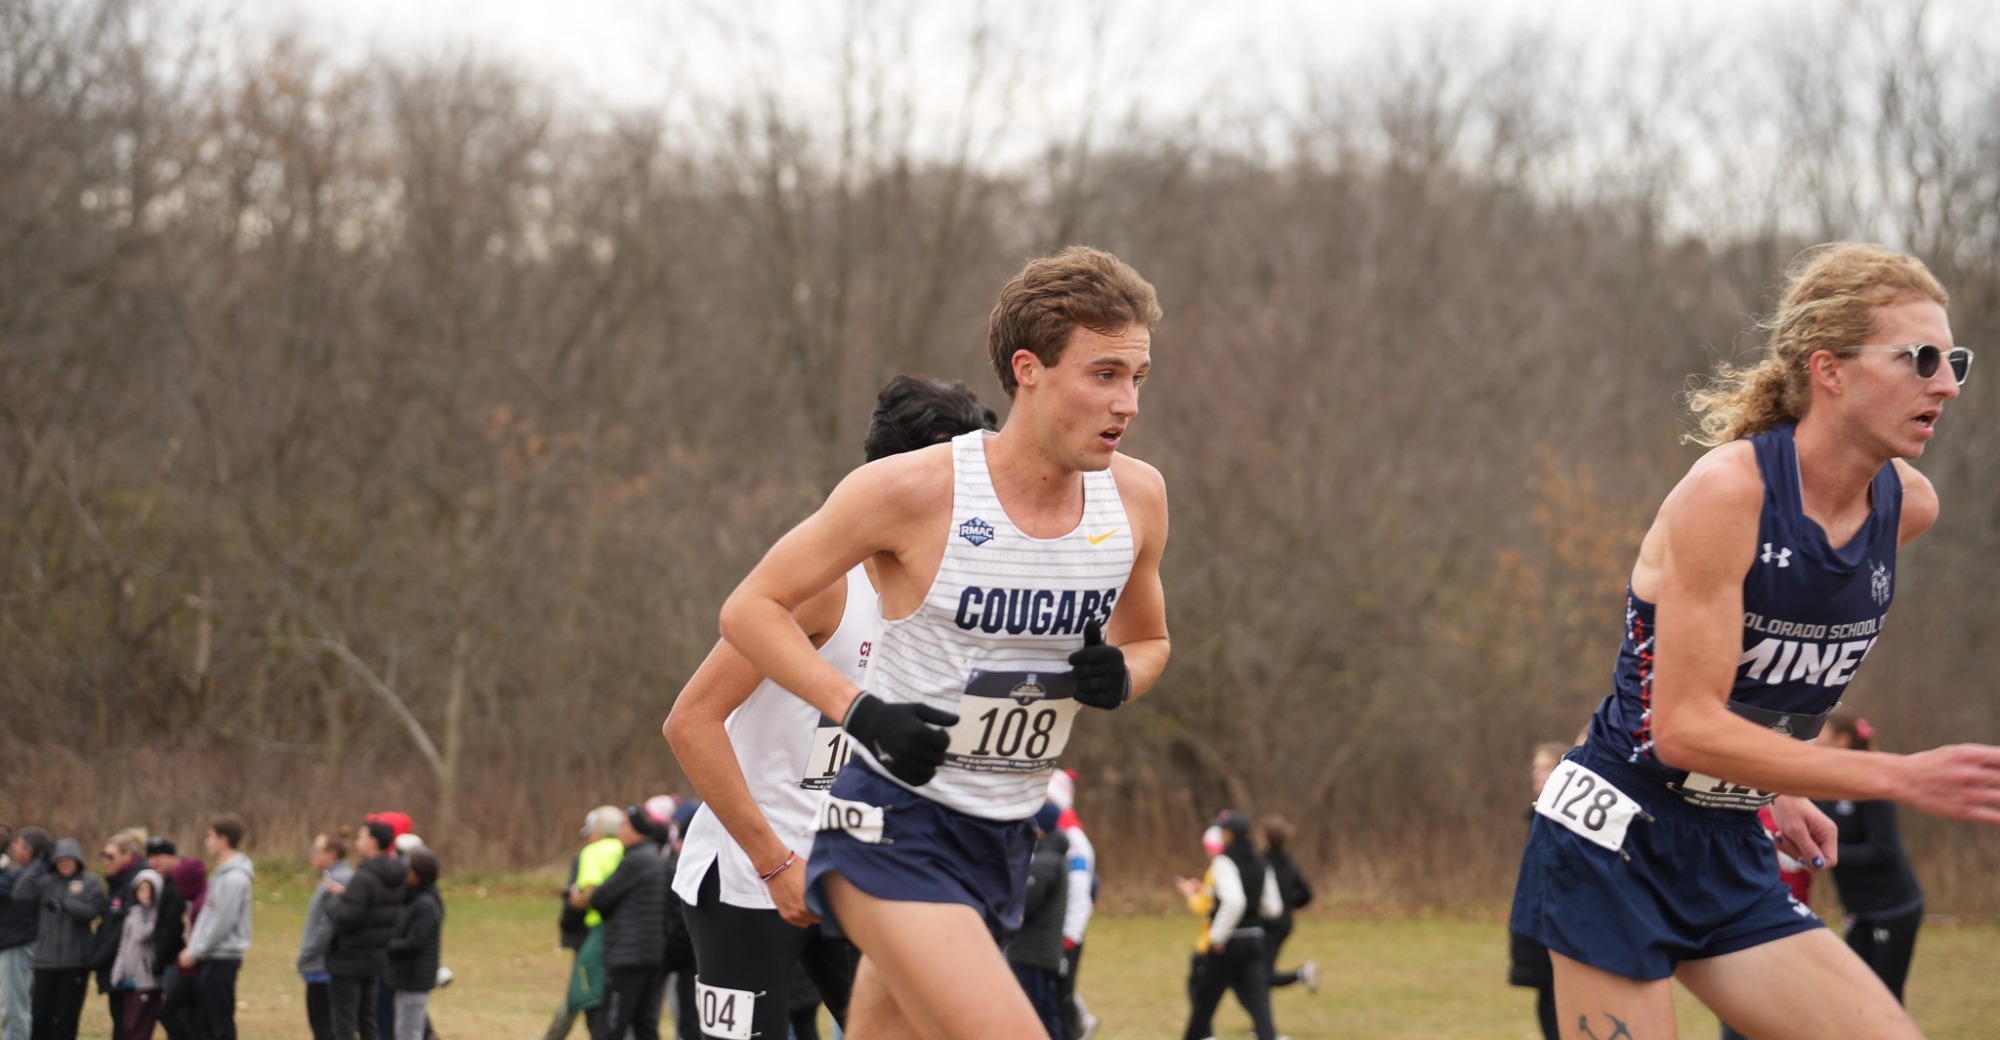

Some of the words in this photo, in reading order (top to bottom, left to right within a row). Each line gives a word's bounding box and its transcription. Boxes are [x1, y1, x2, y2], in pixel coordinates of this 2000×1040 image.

[960, 525, 994, 538] RMAC
[954, 585, 1117, 636] COUGARS
[1743, 611, 1827, 640] OLORADO
[1828, 617, 1877, 640] SCHOOL
[1737, 634, 1879, 688] MINE
[970, 707, 1057, 759] 108
[827, 803, 863, 829] 08
[1551, 769, 1618, 832] 128
[698, 988, 736, 1032] 04
